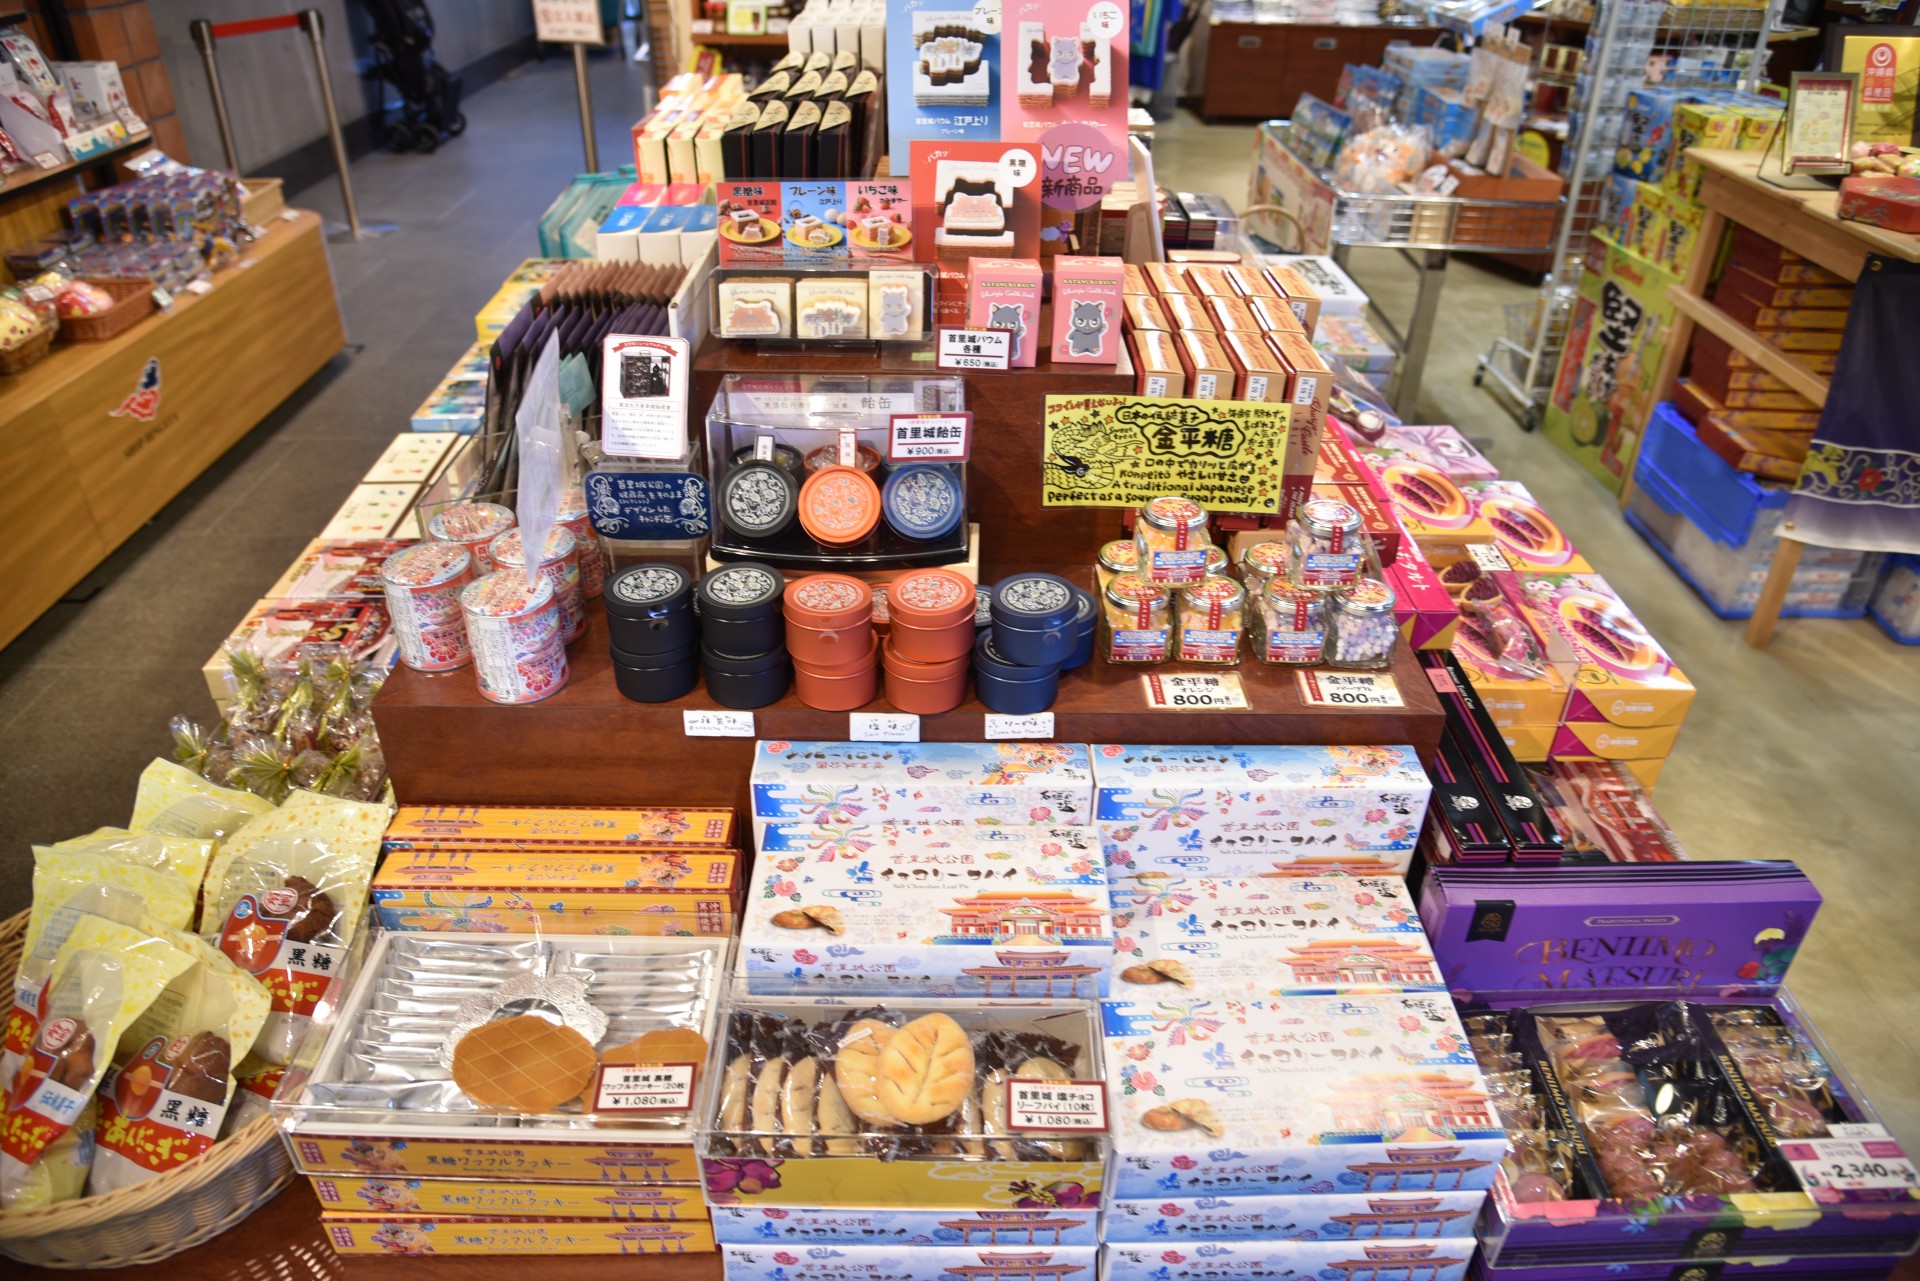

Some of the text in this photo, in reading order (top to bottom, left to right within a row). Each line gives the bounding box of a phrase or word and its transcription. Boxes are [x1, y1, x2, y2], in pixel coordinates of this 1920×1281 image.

[953, 116, 989, 126] 江戸上り
[1042, 144, 1114, 175] NEW
[732, 187, 765, 197] 黒糖味
[788, 186, 837, 196] プレーン味
[858, 185, 899, 196] いちご味
[1042, 175, 1103, 198] 新商品
[948, 334, 1003, 344] 首里城バウム
[963, 344, 982, 354] 各種
[1122, 409, 1200, 424] 日本の伝統菓子
[896, 426, 962, 440] 首里城飴缶
[1151, 425, 1235, 452] 金平糖
[1111, 480, 1121, 489] A
[1122, 481, 1194, 492] traditional
[1098, 493, 1113, 502] as
[1114, 494, 1123, 502] a
[1171, 677, 1220, 687] 金平糖
[1326, 675, 1374, 686] 金平糖
[1514, 935, 1717, 965] BENIIMO
[287, 948, 332, 971] 黒糖
[1515, 965, 1706, 994] MATSURI
[1018, 1090, 1094, 1101] 首里城 塩チョコ
[1719, 1055, 1778, 1149] BENIIMO MATSURI
[160, 1099, 212, 1128] 黒糖
[1537, 1060, 1588, 1155] BENIIMO MATSURI
